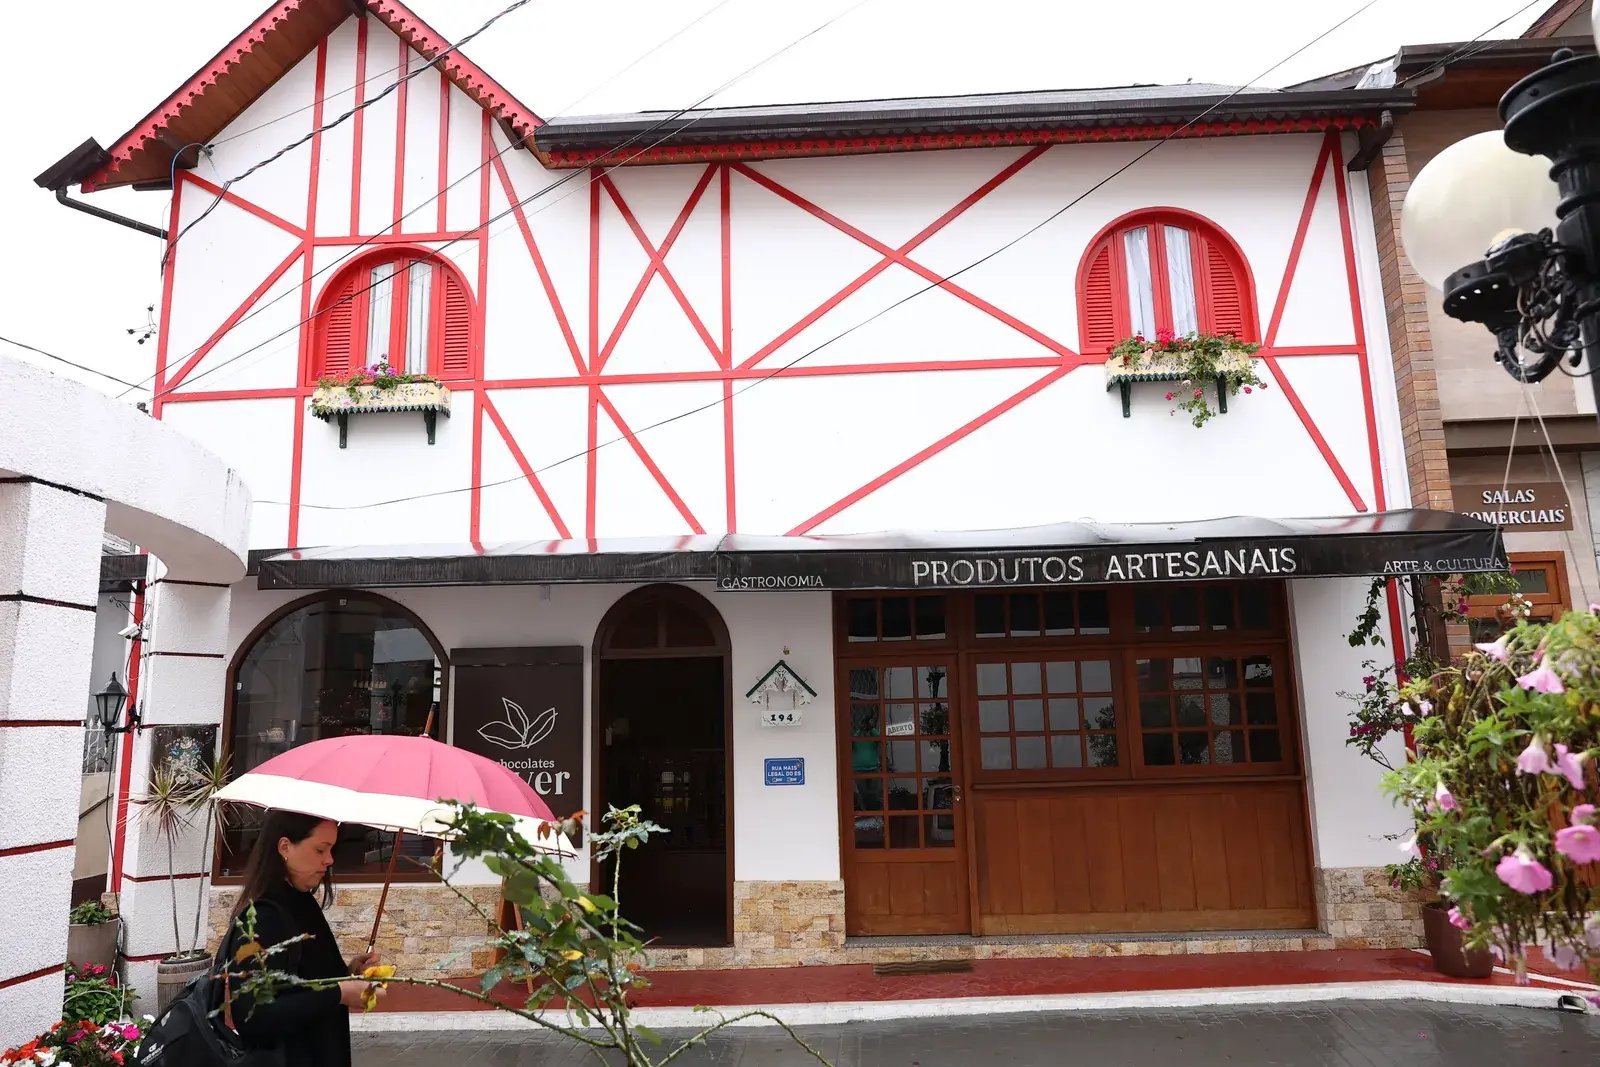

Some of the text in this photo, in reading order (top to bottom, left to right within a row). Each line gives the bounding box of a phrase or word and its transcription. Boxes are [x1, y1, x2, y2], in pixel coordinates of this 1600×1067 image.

[1482, 489, 1536, 504] SALAS
[912, 548, 1297, 586] PRODUTOS ARTESANAIS
[1383, 557, 1505, 573] ARTE & CULTURA
[721, 575, 824, 589] GASTRONOMIA
[770, 713, 793, 722] 194
[888, 724, 912, 734] ABERTO
